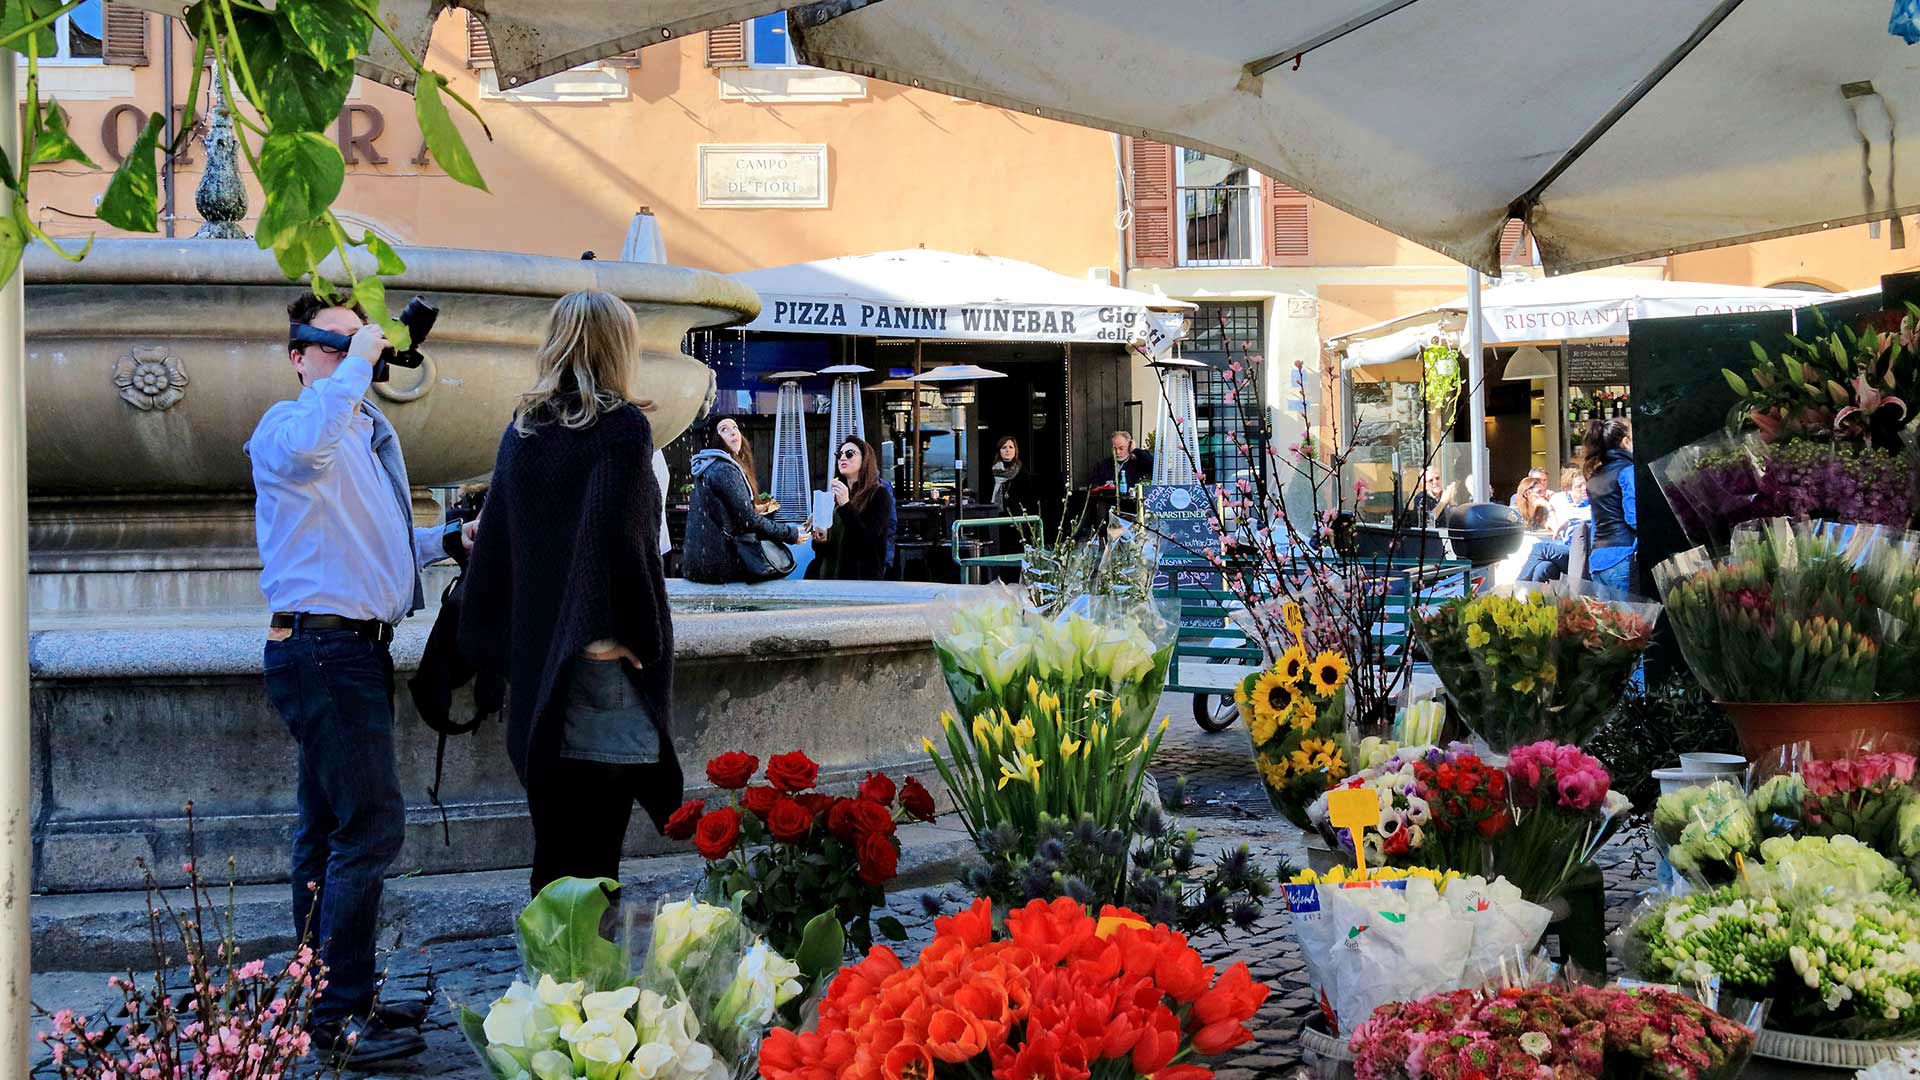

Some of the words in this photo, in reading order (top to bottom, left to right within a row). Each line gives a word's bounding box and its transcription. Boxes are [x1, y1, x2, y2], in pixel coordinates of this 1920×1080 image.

[736, 159, 788, 170] CAMPO
[755, 181, 797, 193] FIORI
[774, 301, 847, 327] PIZZA
[860, 304, 947, 331] PANINI
[961, 308, 1077, 334] WINEBAR
[1503, 307, 1635, 330] RISTORANTE
[1144, 486, 1166, 509] PIZZA
[1156, 485, 1177, 510] PASTA
